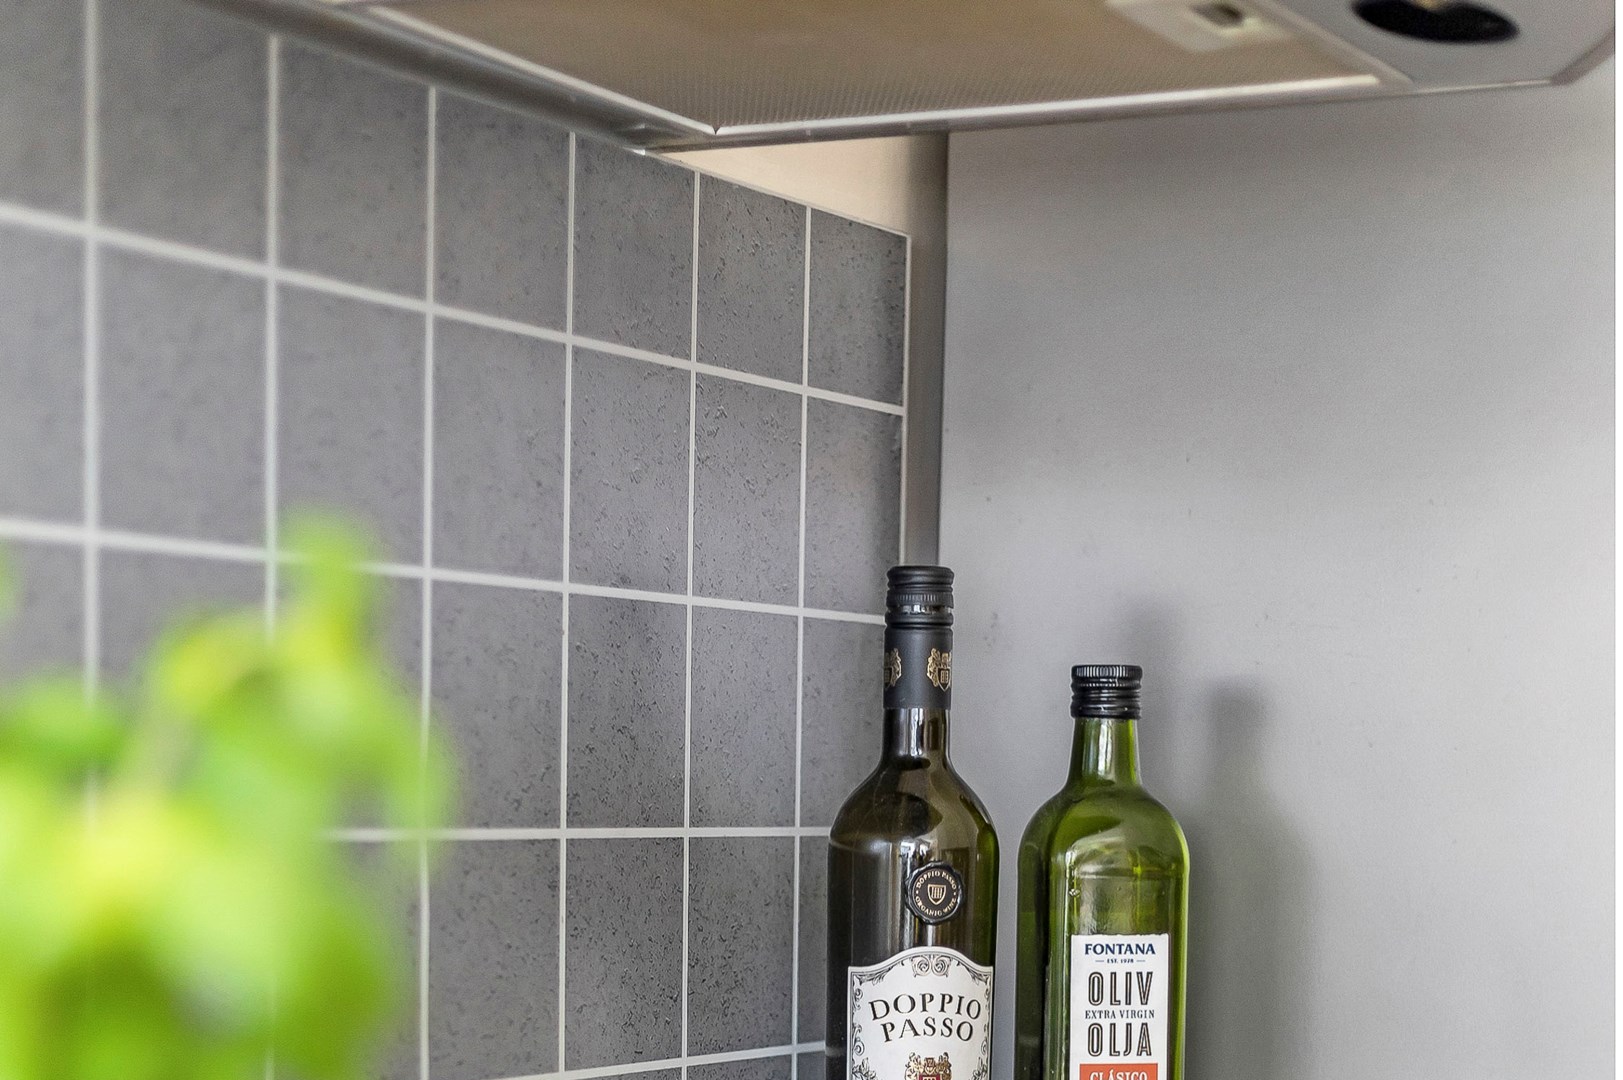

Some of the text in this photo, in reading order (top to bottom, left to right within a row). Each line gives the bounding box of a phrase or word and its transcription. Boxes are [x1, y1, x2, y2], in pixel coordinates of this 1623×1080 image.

[1084, 943, 1156, 955] FONTANA
[1088, 971, 1154, 1006] OLIV
[868, 992, 981, 1021] DOPPIO
[1085, 1009, 1155, 1019] EXTRA VIRGIN
[881, 1016, 973, 1042] PASSO
[1087, 1022, 1152, 1057] OLJA
